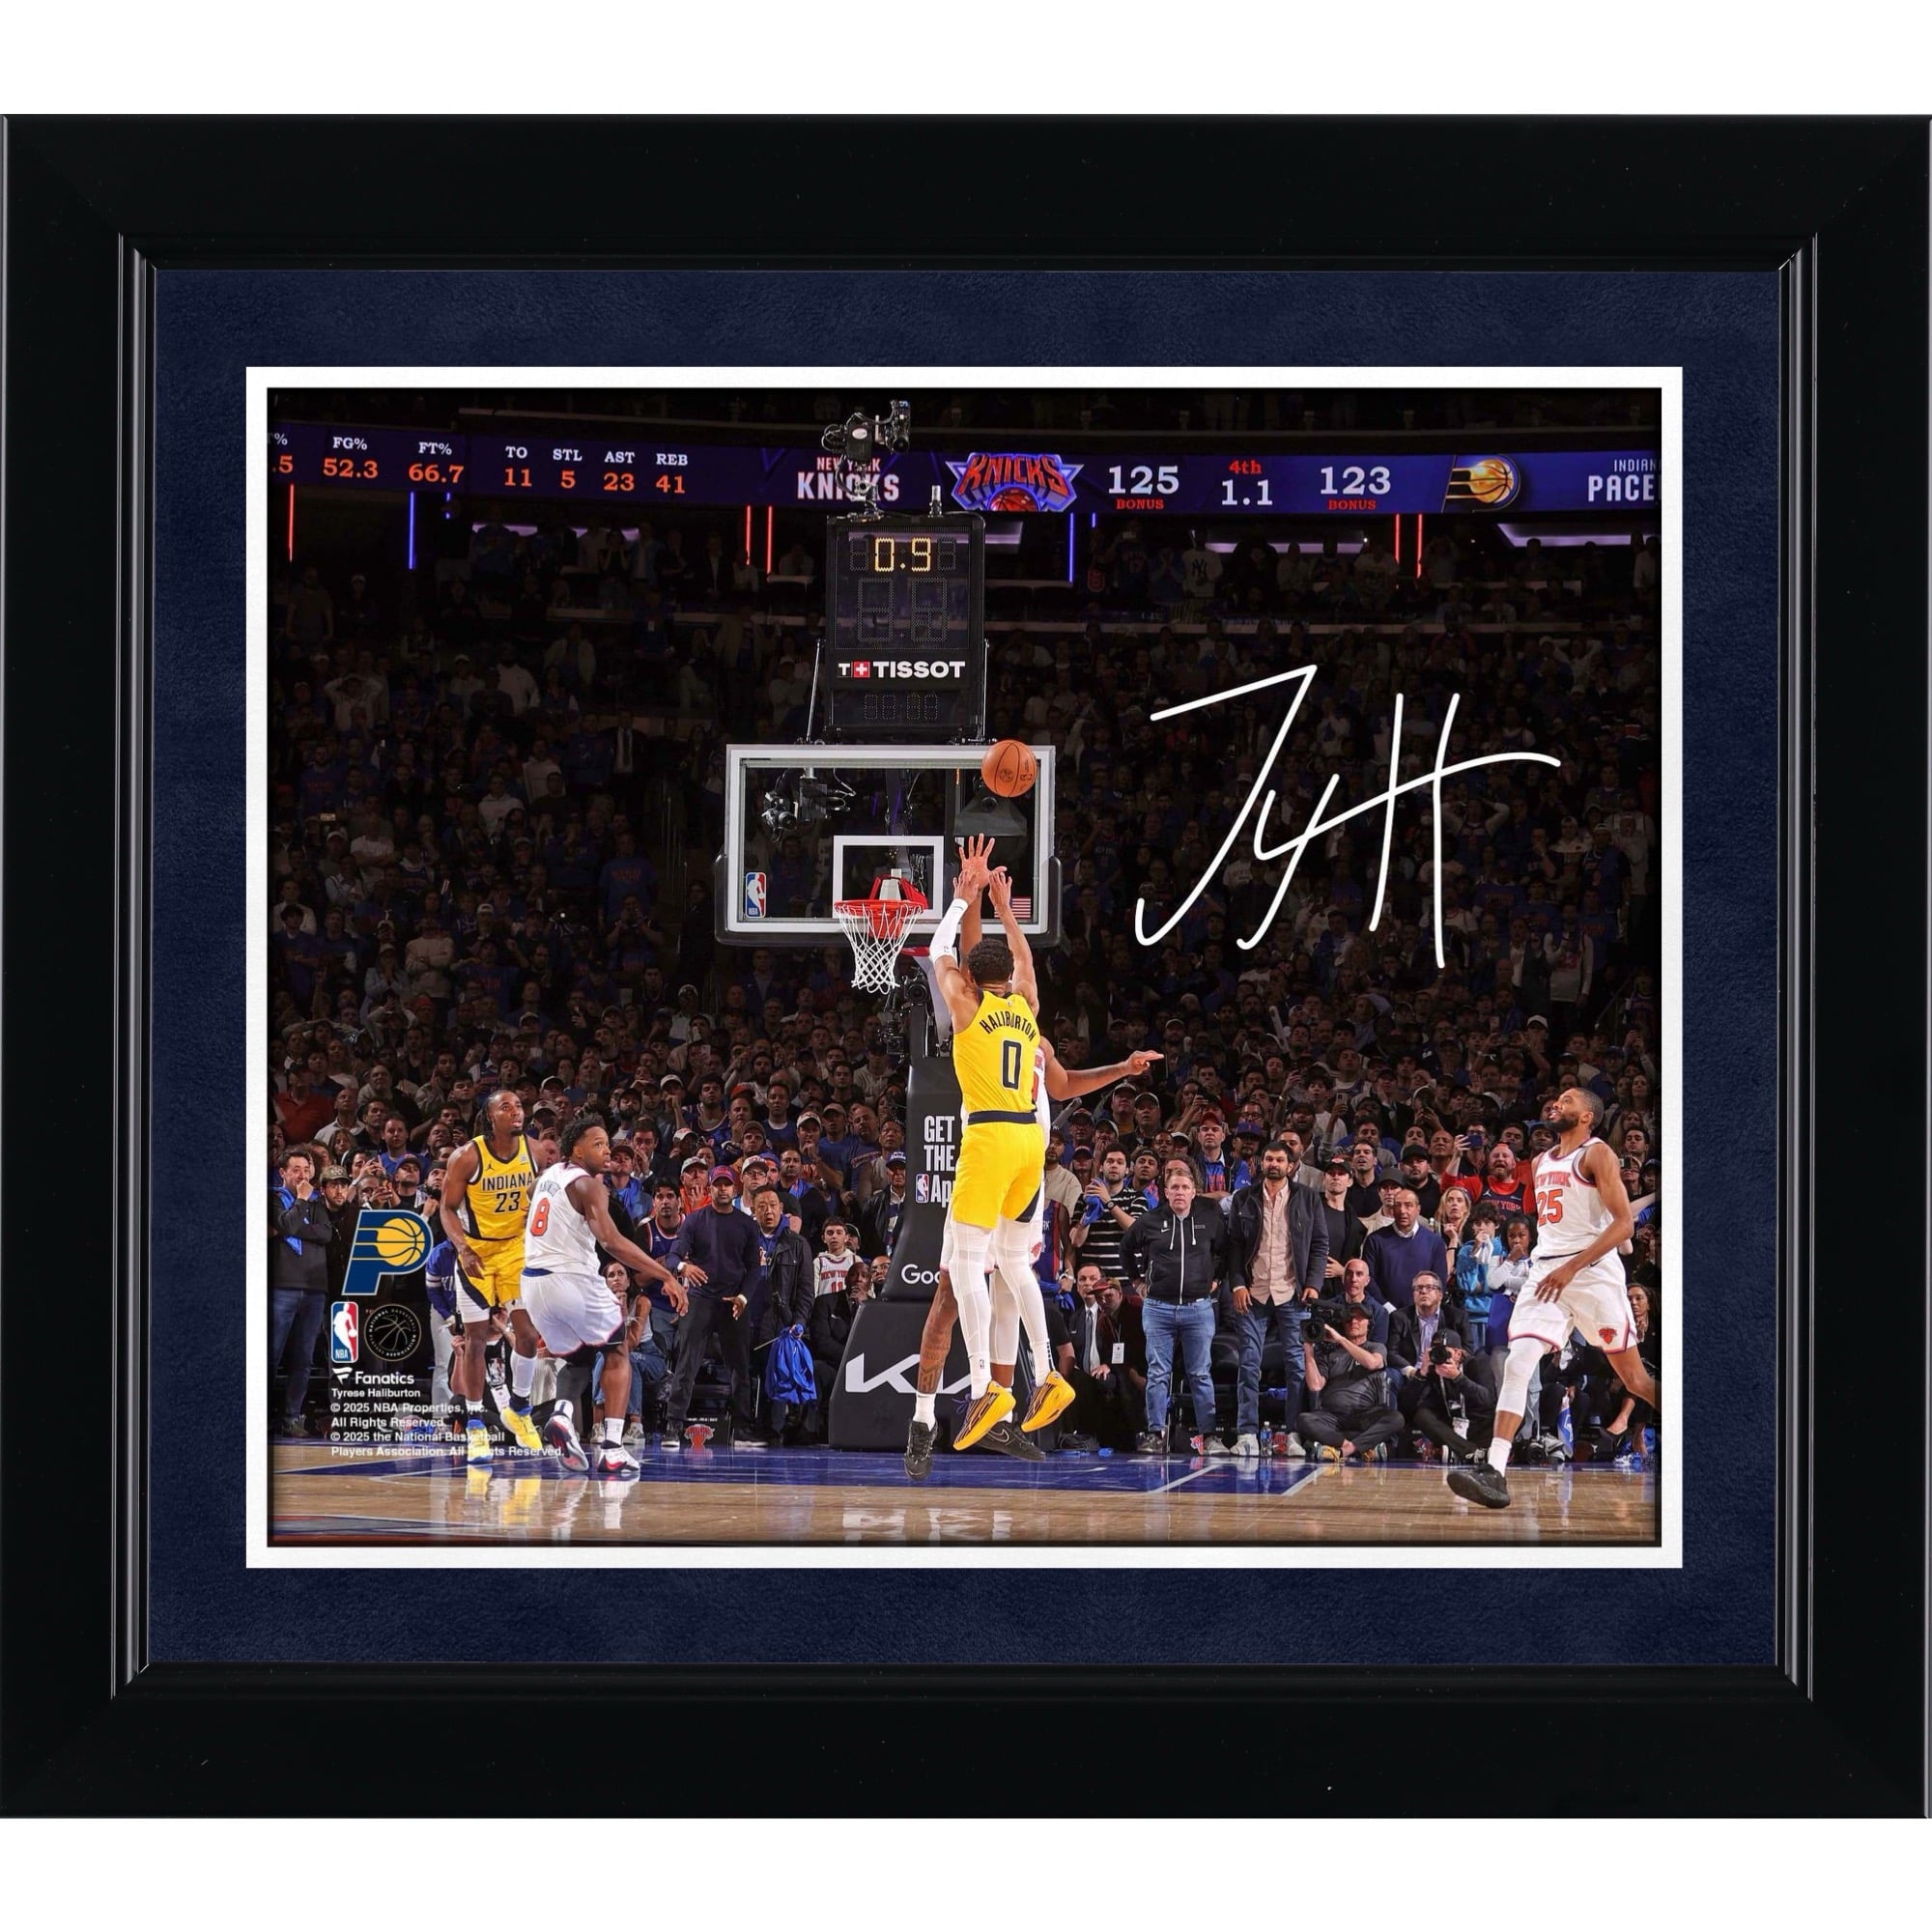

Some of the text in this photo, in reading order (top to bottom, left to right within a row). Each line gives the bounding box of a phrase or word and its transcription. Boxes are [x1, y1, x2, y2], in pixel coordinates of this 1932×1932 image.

[332, 436, 368, 450] FG%
[418, 441, 452, 455] FT%
[505, 445, 528, 459] TO
[553, 448, 582, 462] STL
[604, 451, 635, 464] AST
[656, 453, 688, 466] REB
[846, 458, 881, 471] YK
[1614, 458, 1661, 471] INDIAN
[323, 458, 379, 478] 52.3
[409, 464, 464, 483] 66.7
[504, 469, 532, 486] 11
[560, 469, 576, 488] 5
[603, 472, 635, 492] 23
[656, 474, 686, 494] 41
[957, 454, 1070, 497] KNICKS
[1109, 465, 1179, 495] 125
[1229, 460, 1262, 474] 4th
[1321, 467, 1391, 495] 123
[1222, 479, 1272, 505] 1.1
[1588, 474, 1661, 502] PACE
[1116, 499, 1164, 509] BONUS
[1328, 499, 1376, 510] BONUS
[874, 537, 931, 572] 0.9
[873, 661, 966, 678] TISSOT
[979, 1010, 1037, 1042] HALIBURTON
[1002, 1039, 1022, 1091] 0
[923, 1115, 955, 1143] GET
[923, 1145, 955, 1171] THE
[482, 1171, 532, 1191] INDIANA
[930, 1175, 956, 1208] Ap
[1548, 1171, 1572, 1188] YORK
[495, 1191, 521, 1212] 23
[1537, 1189, 1563, 1226] 25
[530, 1198, 551, 1237] 8
